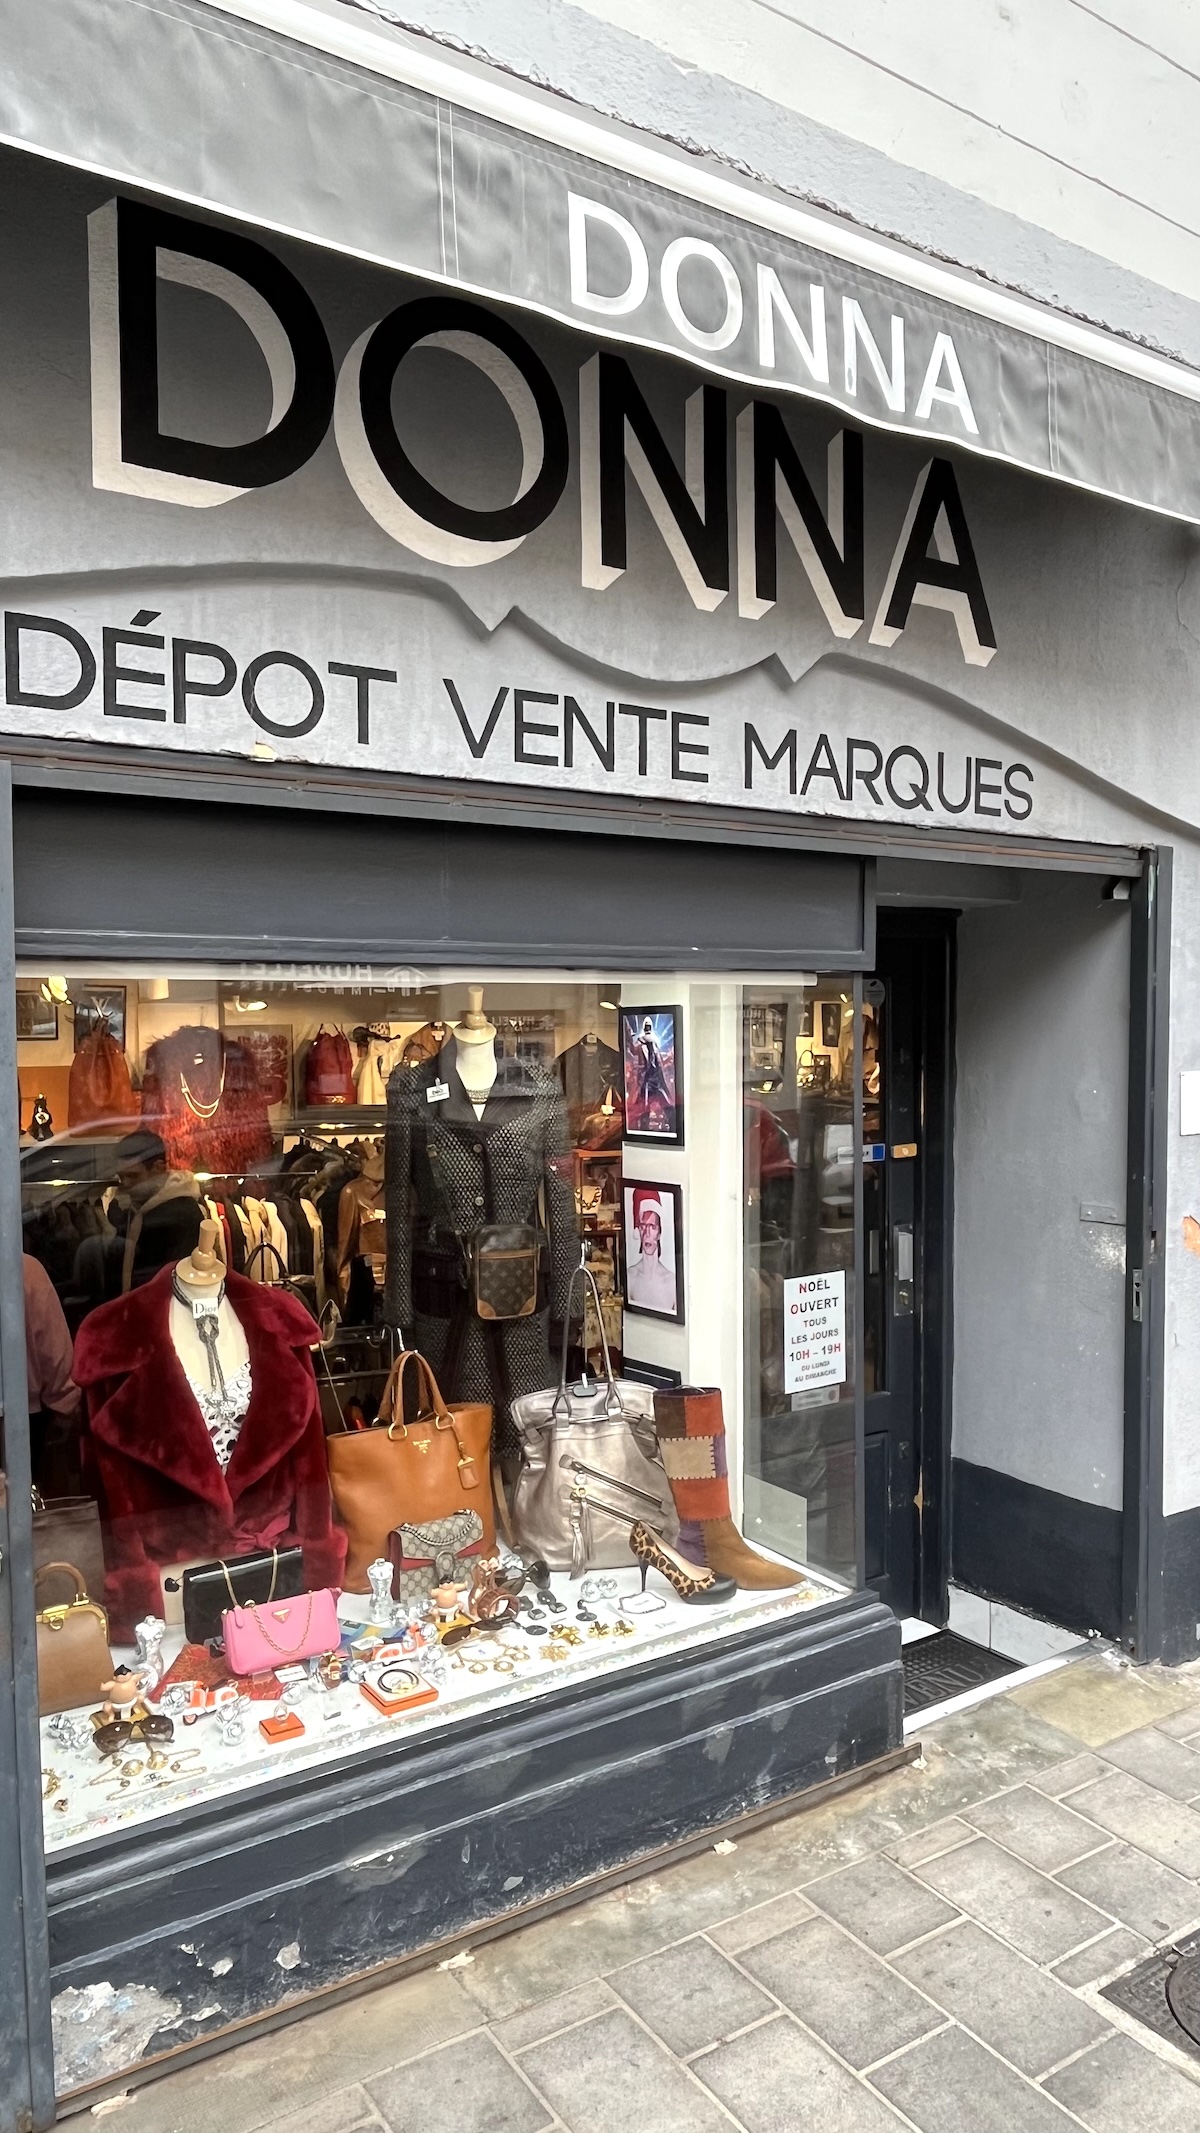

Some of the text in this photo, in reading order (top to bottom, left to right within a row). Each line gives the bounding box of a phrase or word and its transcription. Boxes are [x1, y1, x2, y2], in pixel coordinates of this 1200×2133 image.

[567, 190, 979, 434] DONNA
[88, 196, 997, 667] DONNA
[4, 609, 1034, 821] DÉPOT VENTE MARQUES
[790, 1297, 839, 1315] OUVERT
[803, 1316, 827, 1328] TOUS
[791, 1328, 839, 1345] LES JOURS
[789, 1349, 810, 1362] 10H
[821, 1343, 841, 1355] 19H
